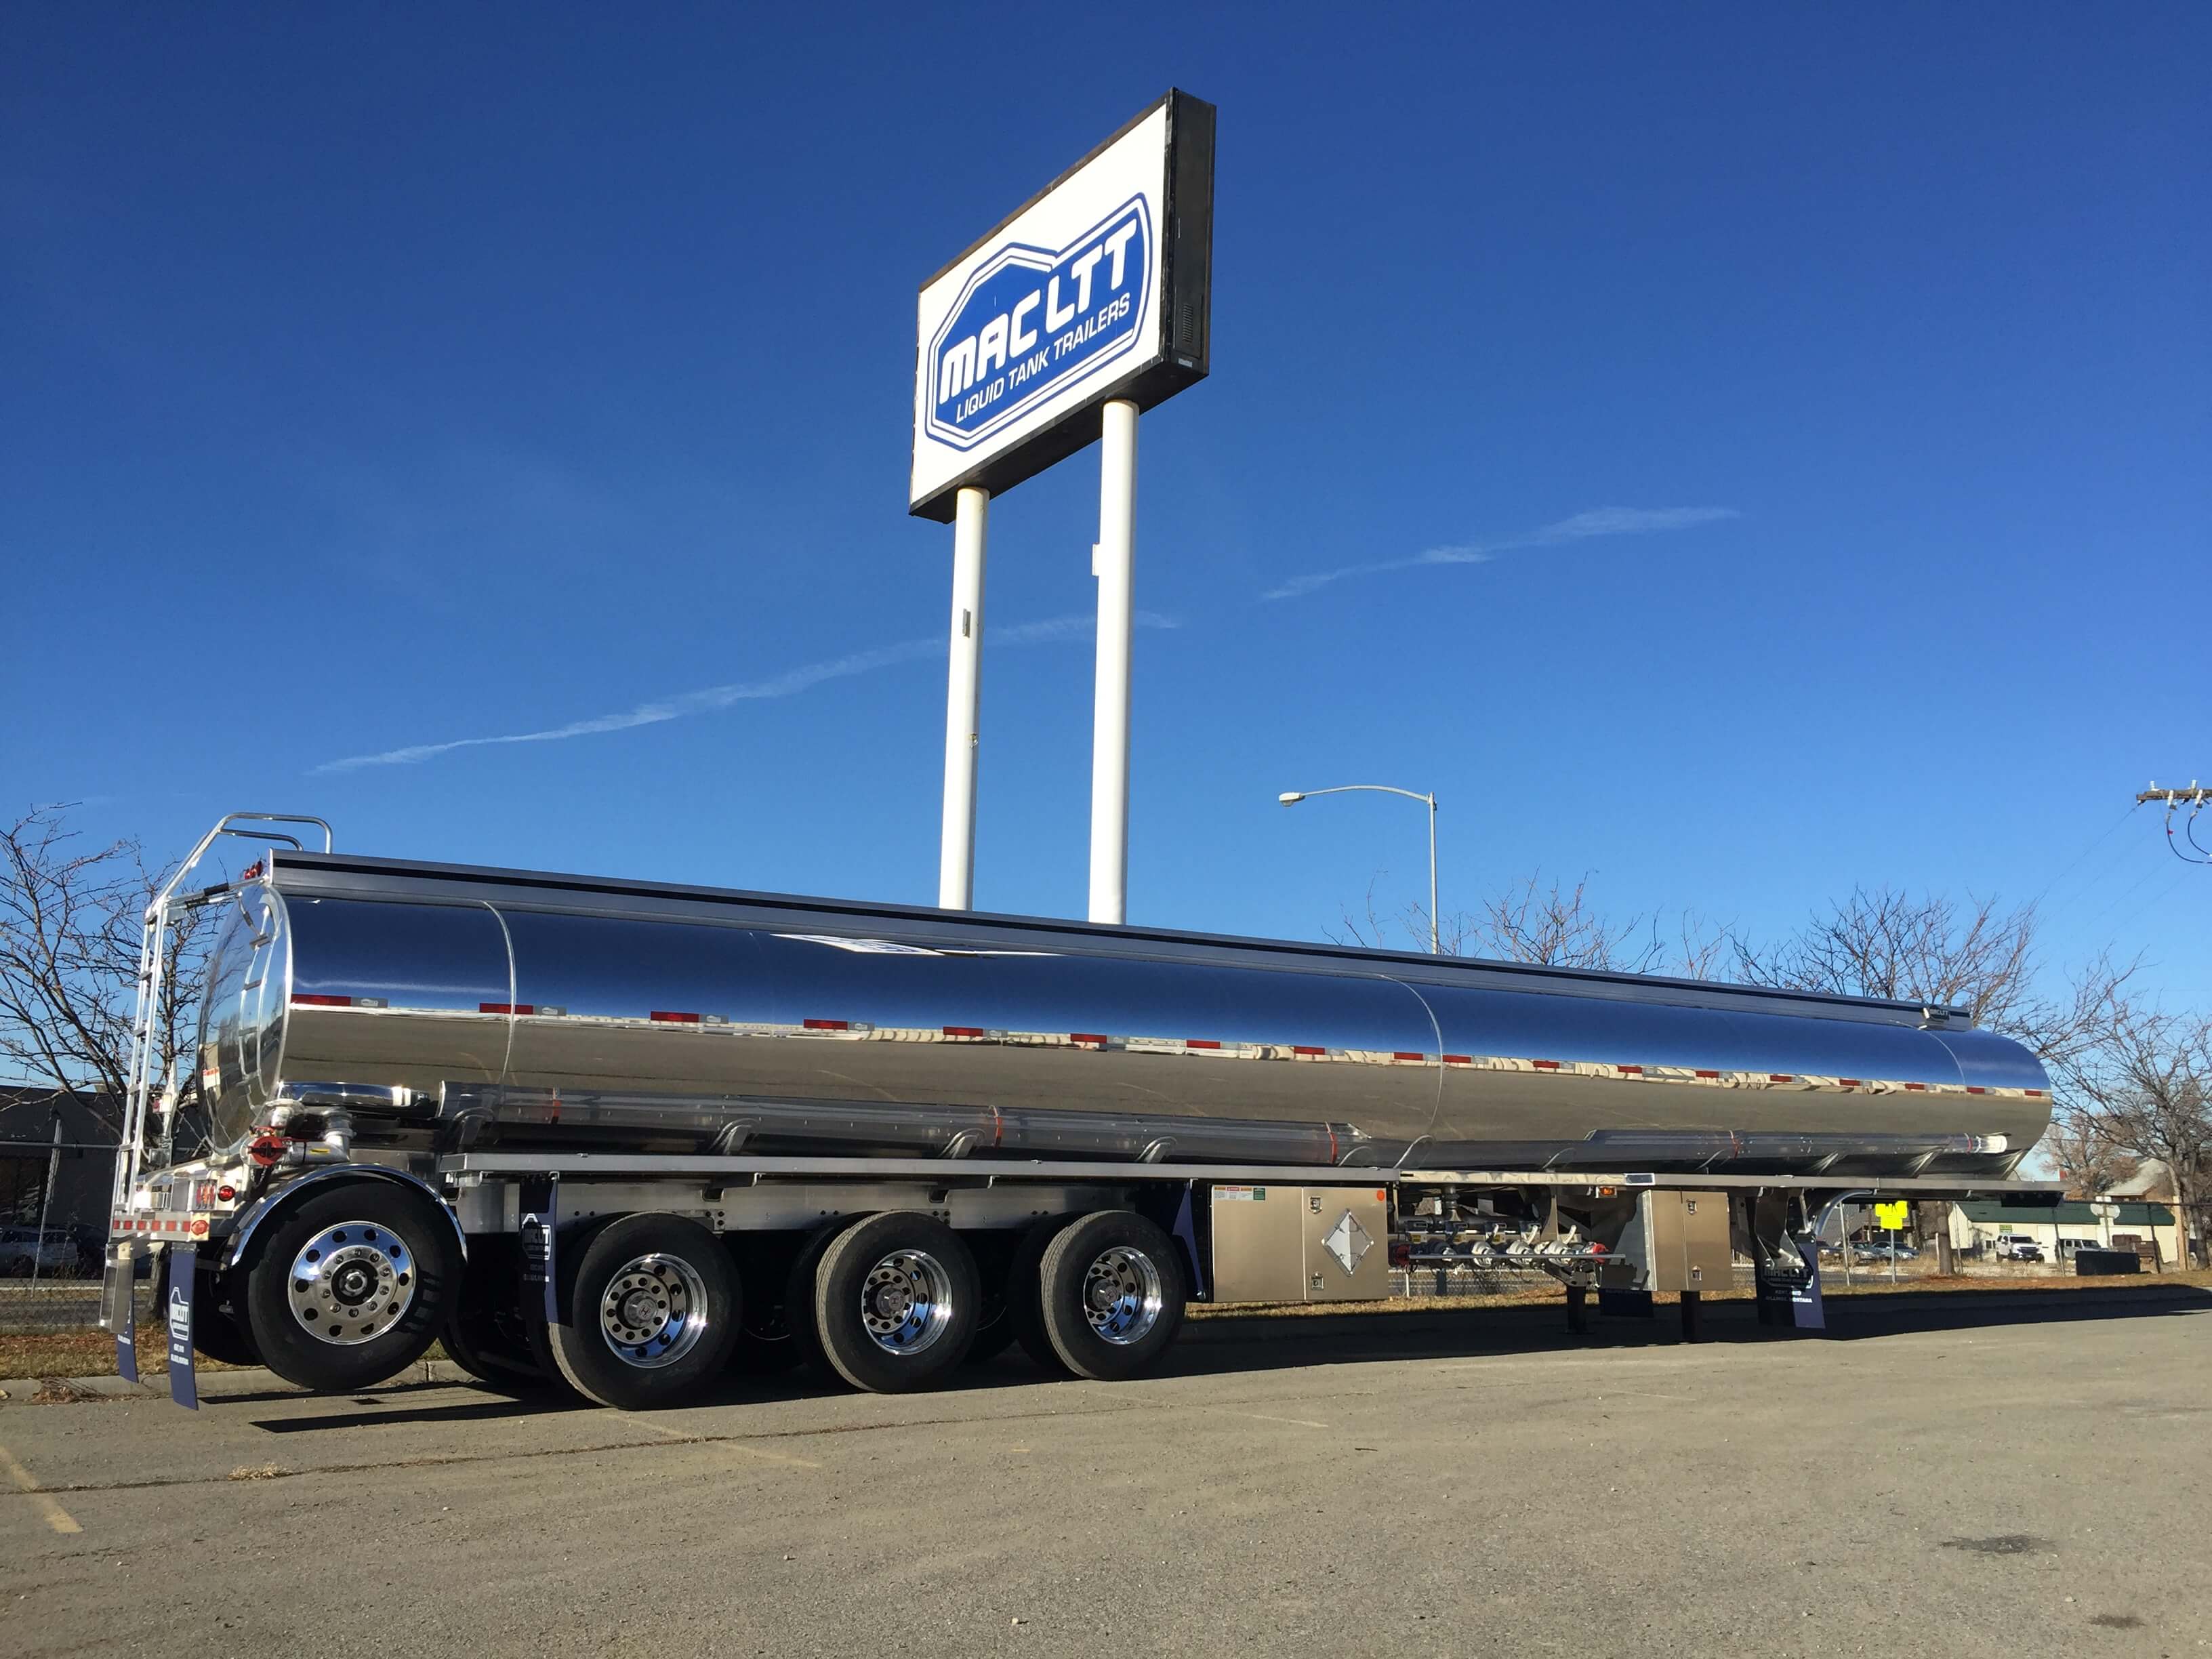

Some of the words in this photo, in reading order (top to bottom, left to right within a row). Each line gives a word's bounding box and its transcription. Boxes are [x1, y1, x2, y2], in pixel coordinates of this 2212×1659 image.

[939, 289, 1040, 405] MAC
[1046, 218, 1137, 333] LTT
[956, 377, 1004, 424] LIQUID
[1008, 346, 1050, 390] TANK
[1054, 292, 1130, 361] TRAILERS
